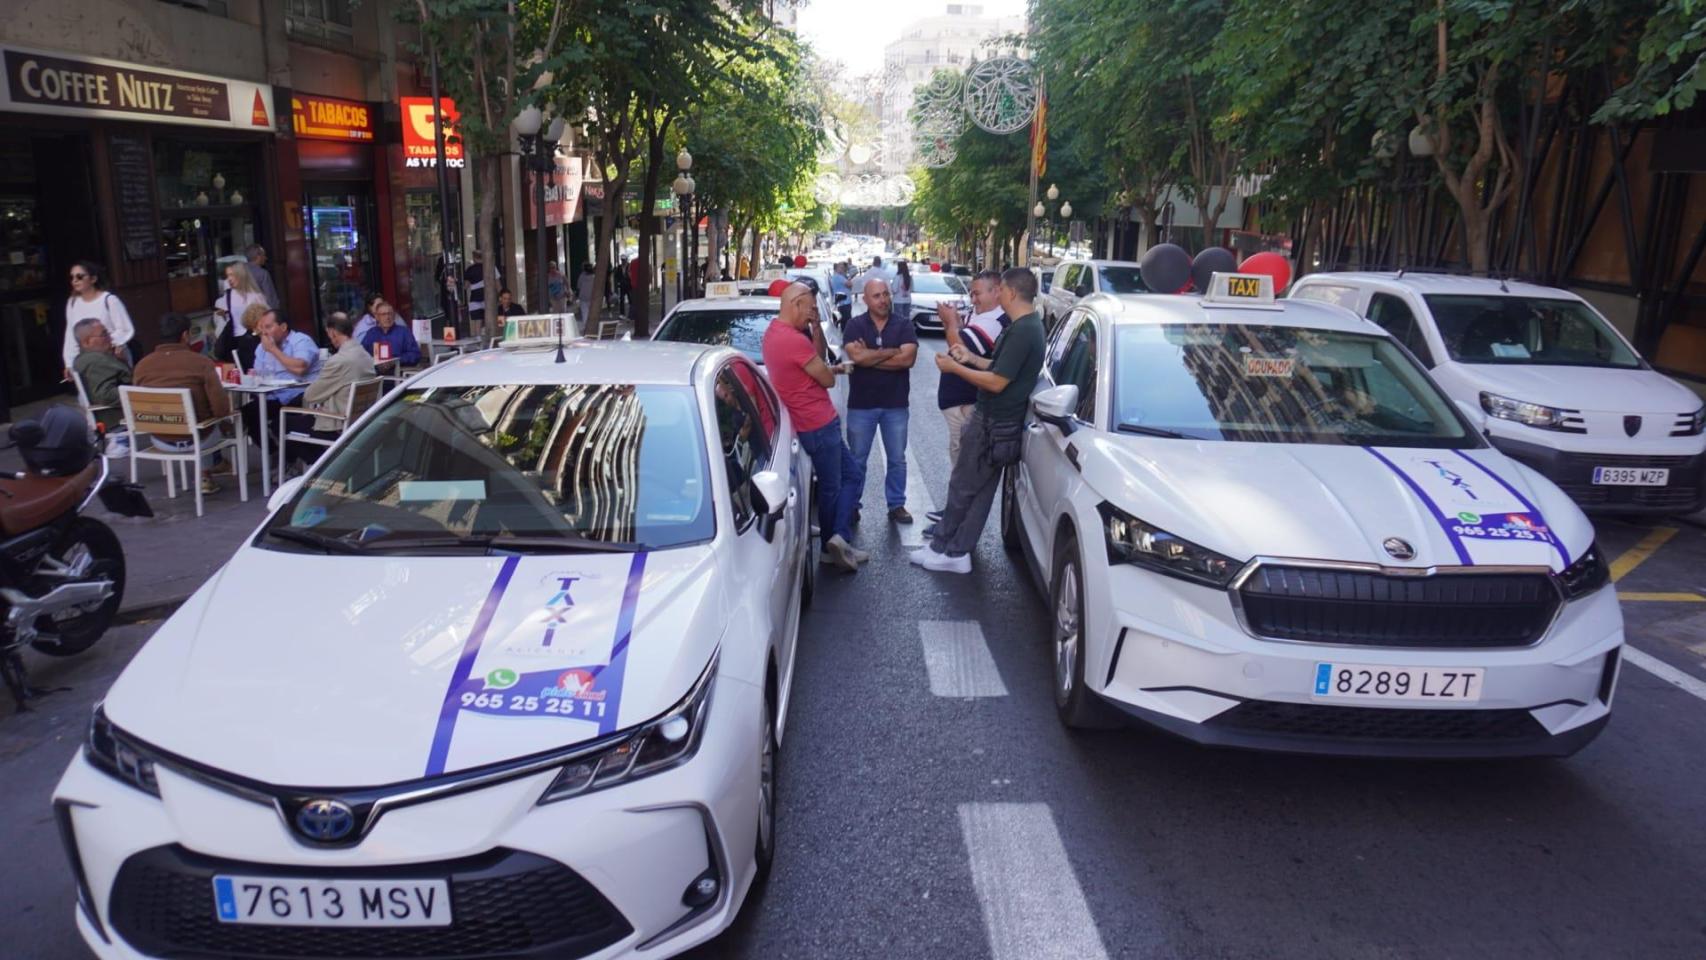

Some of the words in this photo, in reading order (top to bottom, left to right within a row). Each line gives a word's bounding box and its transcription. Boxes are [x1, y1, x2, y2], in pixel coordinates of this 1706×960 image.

[20, 60, 110, 105] COFFEE
[116, 72, 174, 111] NUTZ
[308, 101, 367, 127] TABACOS
[408, 145, 459, 155] TABAOS
[1229, 278, 1259, 296] TAXI
[519, 319, 550, 337] TAXI
[1247, 360, 1291, 375] OCUPADO
[1603, 470, 1636, 483] 6395
[1452, 526, 1486, 536] 965
[1487, 527, 1510, 537] 25
[1512, 529, 1535, 539] 25
[540, 577, 580, 647] TAXI
[1336, 669, 1411, 696] 8289
[1421, 672, 1477, 697] LZT
[461, 692, 503, 709] 965
[509, 695, 539, 712] 25
[545, 698, 574, 715] 25
[583, 701, 606, 717] 11
[242, 884, 345, 918] 7613
[359, 887, 435, 919] MSV
